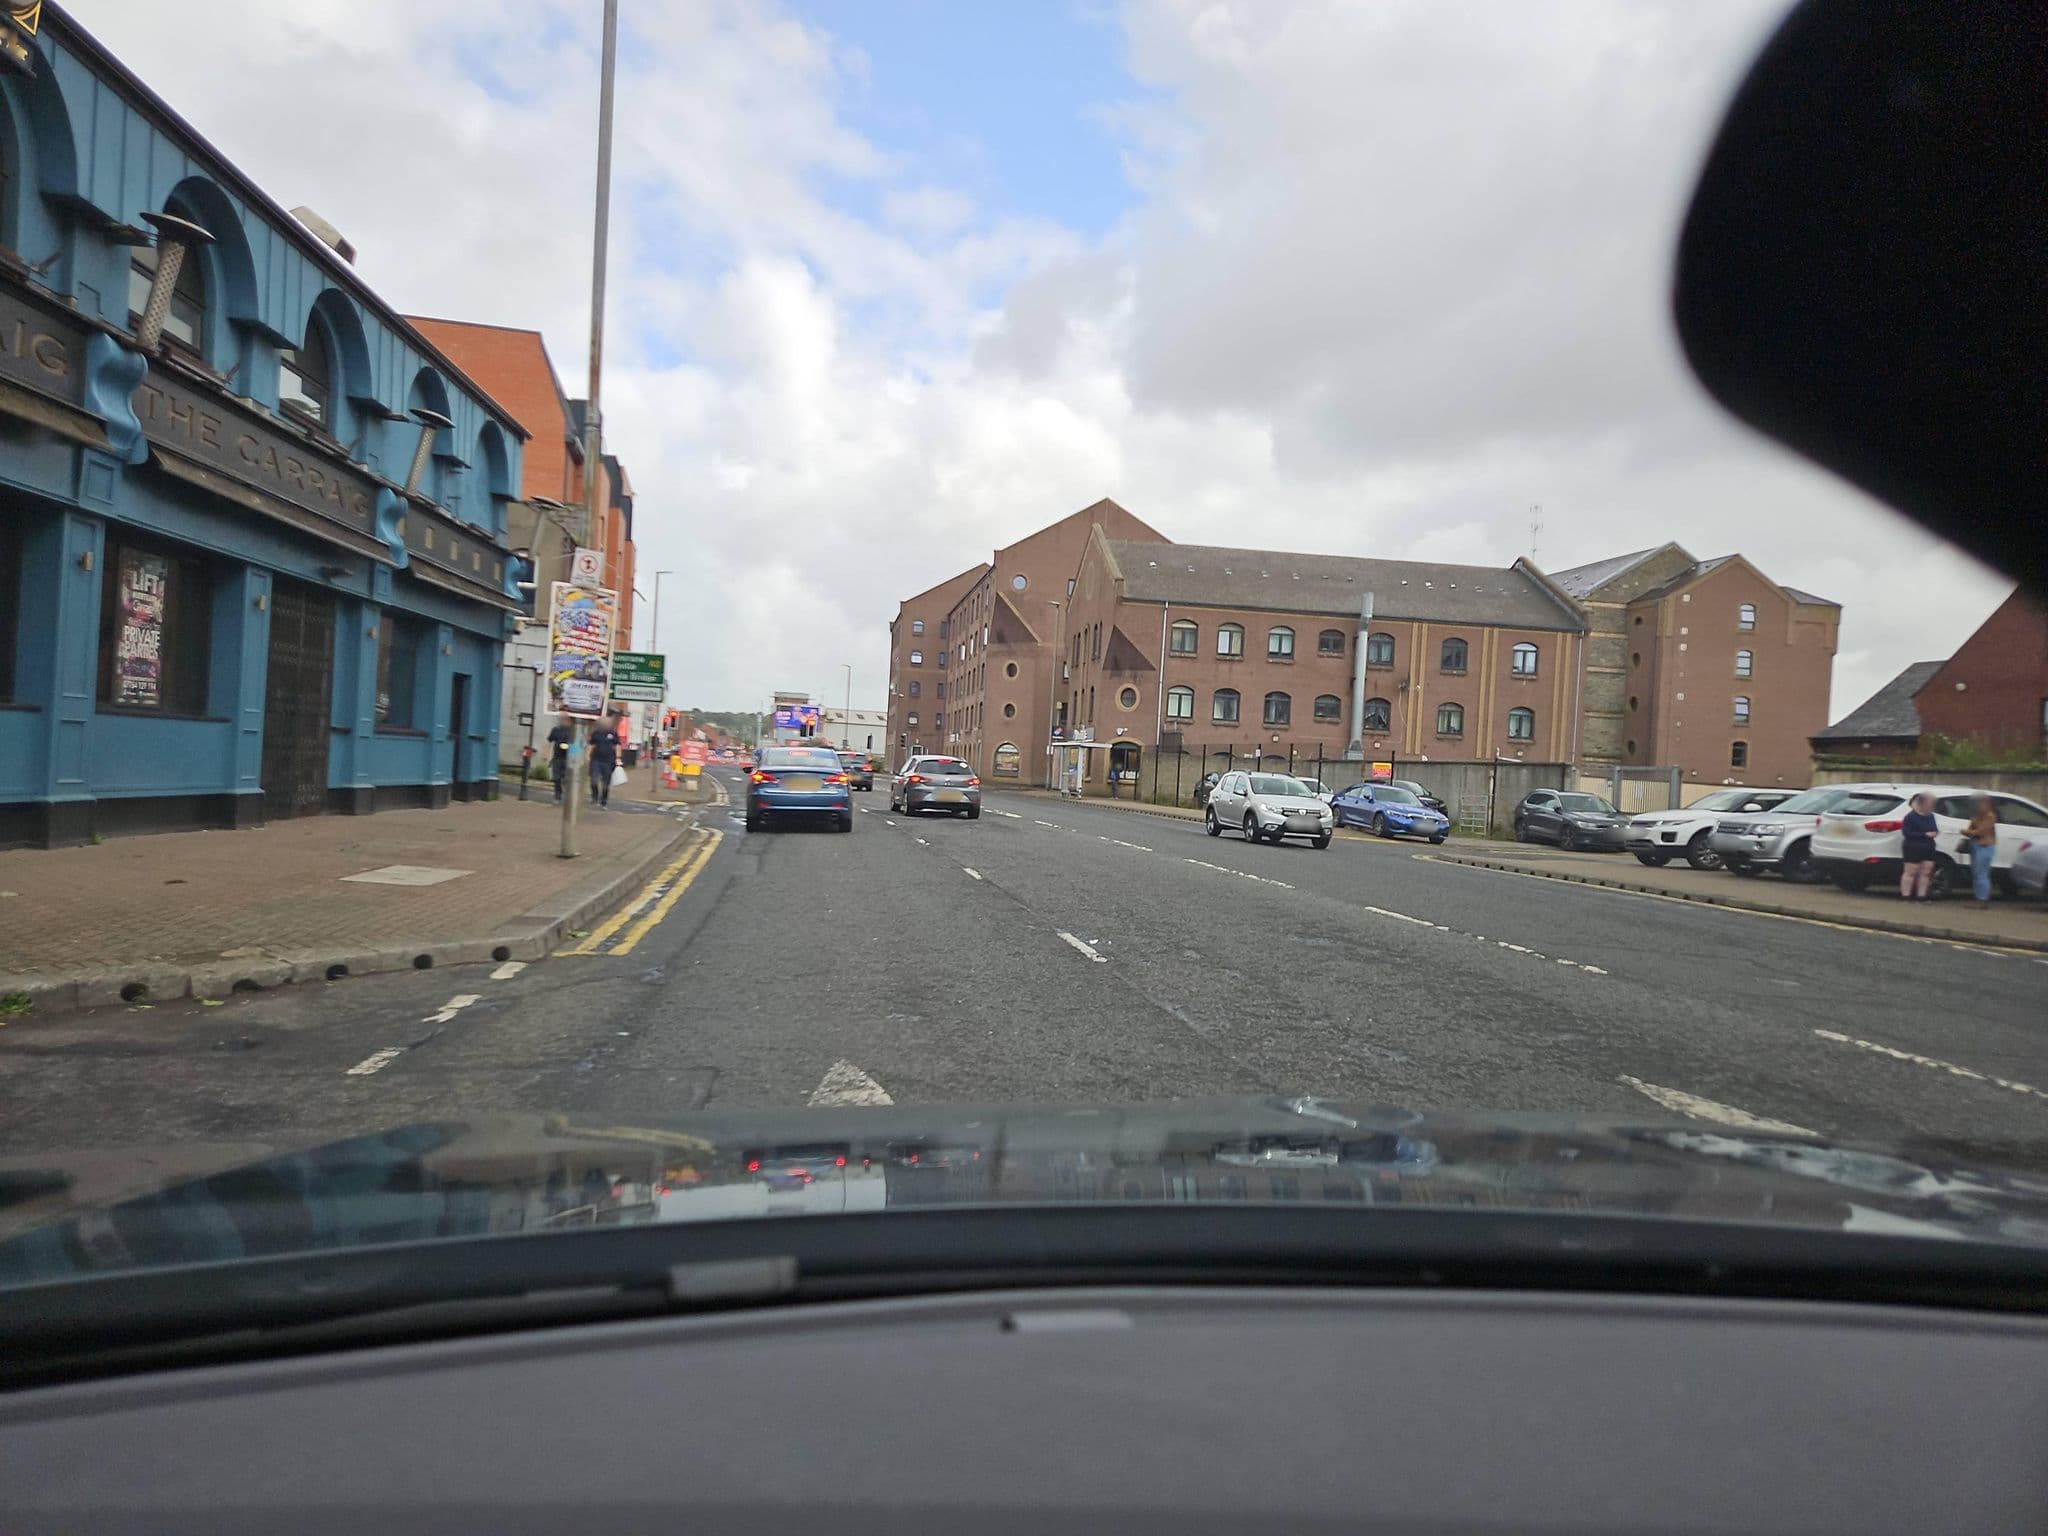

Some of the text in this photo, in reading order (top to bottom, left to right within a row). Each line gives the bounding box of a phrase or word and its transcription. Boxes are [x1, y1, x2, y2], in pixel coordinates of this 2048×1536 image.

[0, 318, 67, 377] IG
[141, 382, 370, 518] THE CARRAIG
[124, 625, 160, 647] PRIVATE
